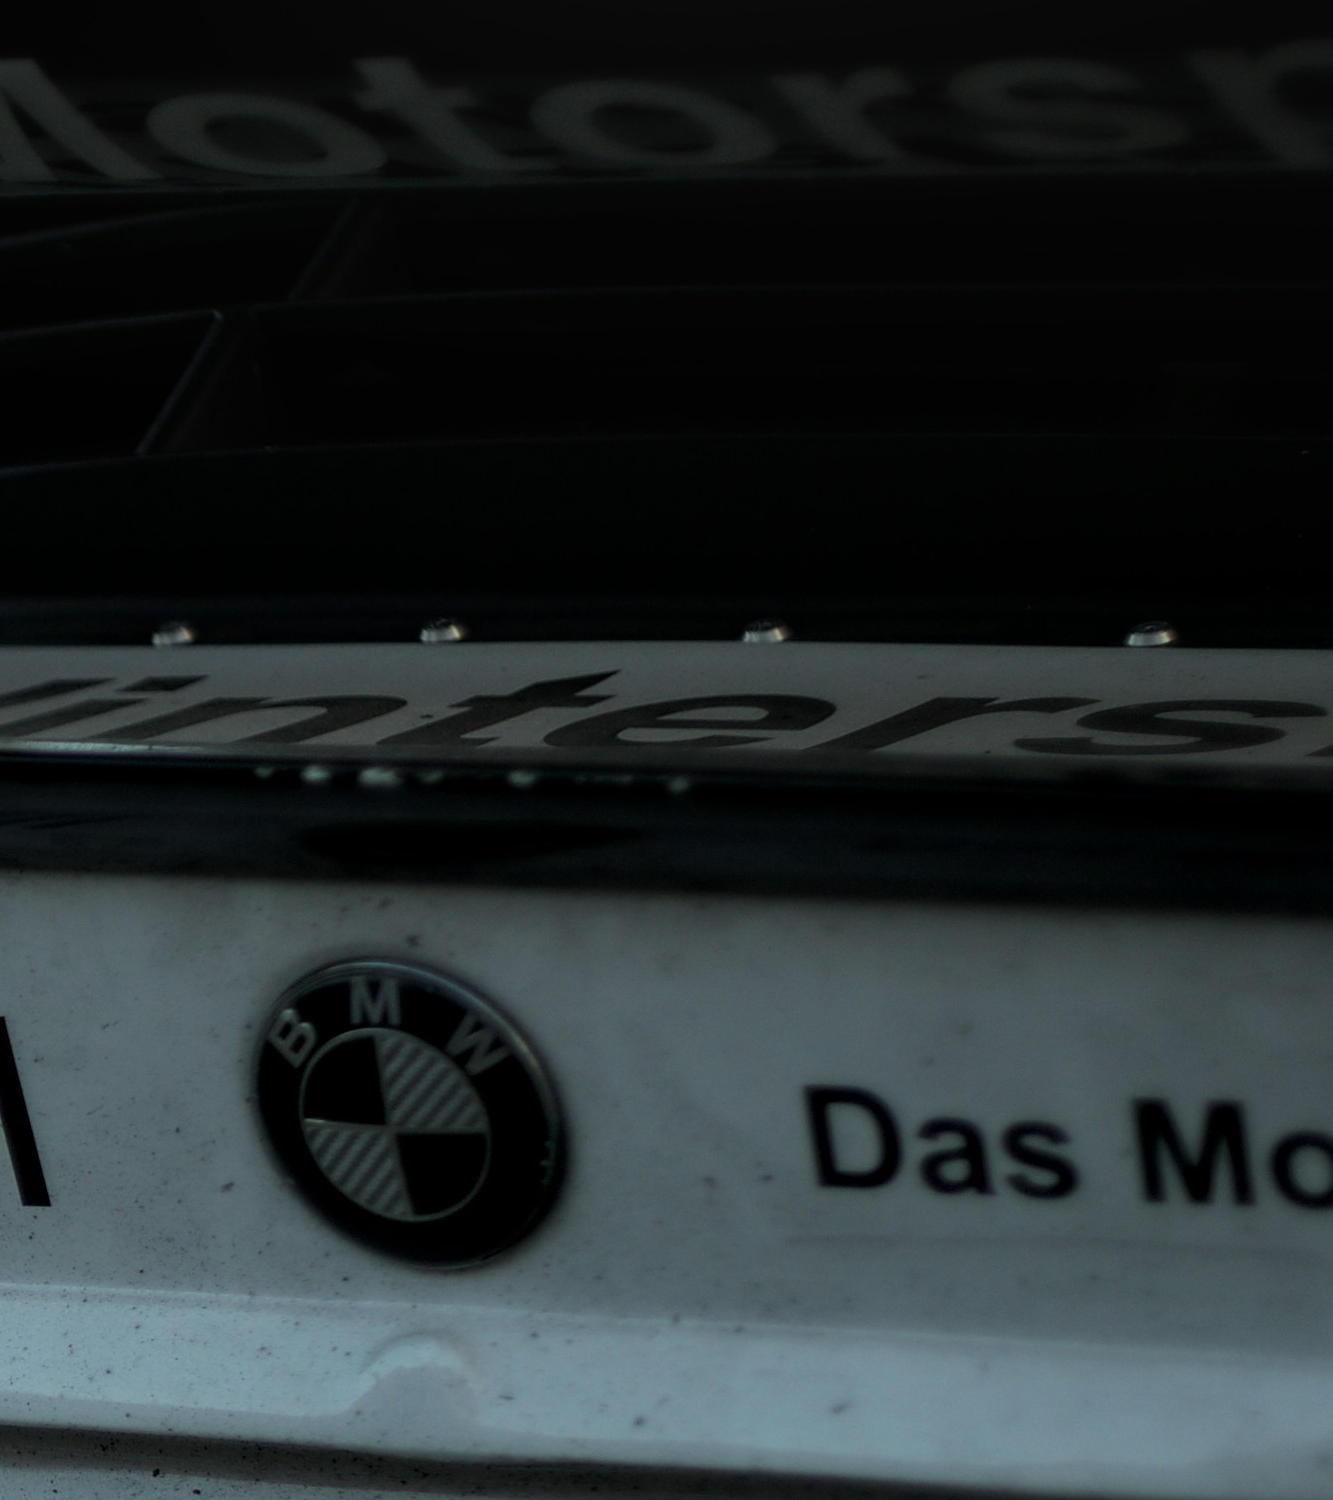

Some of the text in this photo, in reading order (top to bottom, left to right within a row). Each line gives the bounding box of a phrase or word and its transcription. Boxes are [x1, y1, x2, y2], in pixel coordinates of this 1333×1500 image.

[266, 975, 512, 1078] BMW
[804, 1086, 1333, 1208] Das Mo
